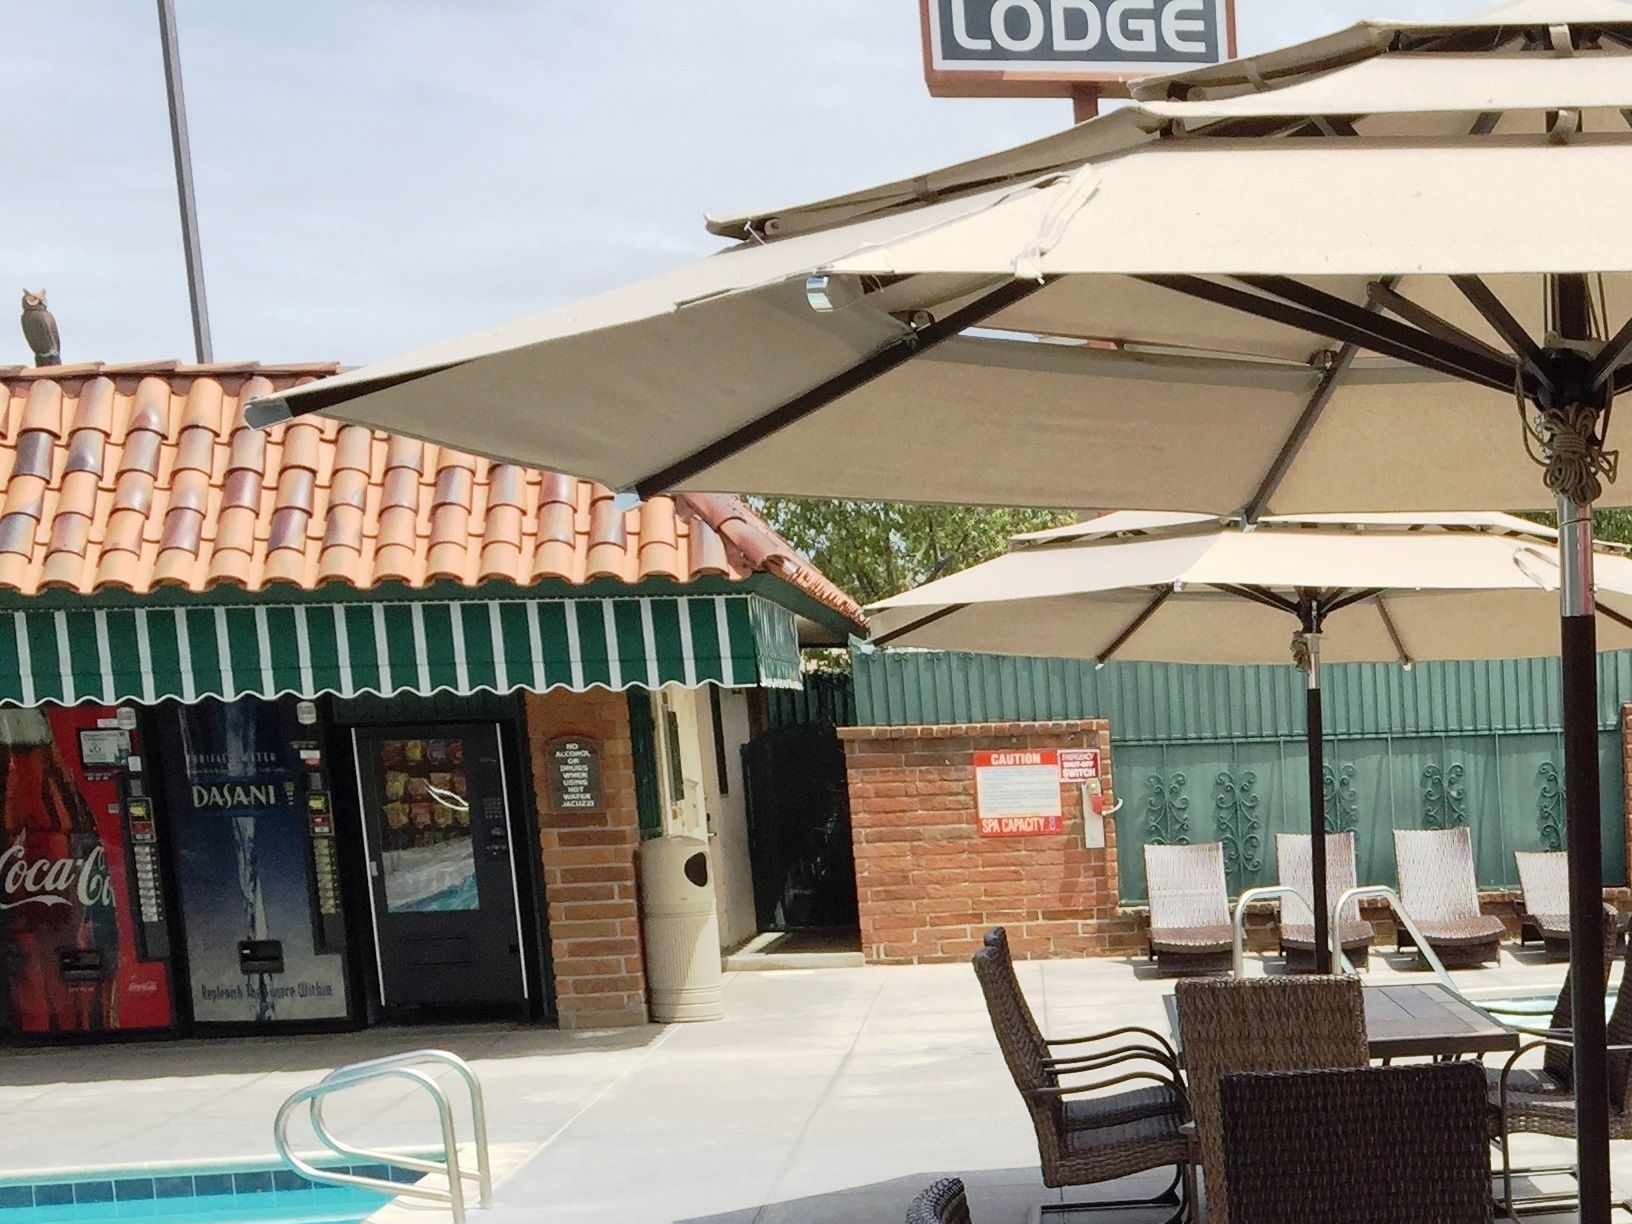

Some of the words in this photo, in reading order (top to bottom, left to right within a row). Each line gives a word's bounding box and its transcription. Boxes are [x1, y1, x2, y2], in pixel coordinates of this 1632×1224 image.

[951, 0, 1206, 52] LODGE
[555, 750, 591, 758] ALCOHOL
[991, 753, 1041, 766] CAUTION
[192, 783, 276, 809] DASANI
[561, 800, 595, 808] JACUZZI
[982, 818, 1000, 833] SPA
[1001, 817, 1045, 832] CAPACITY
